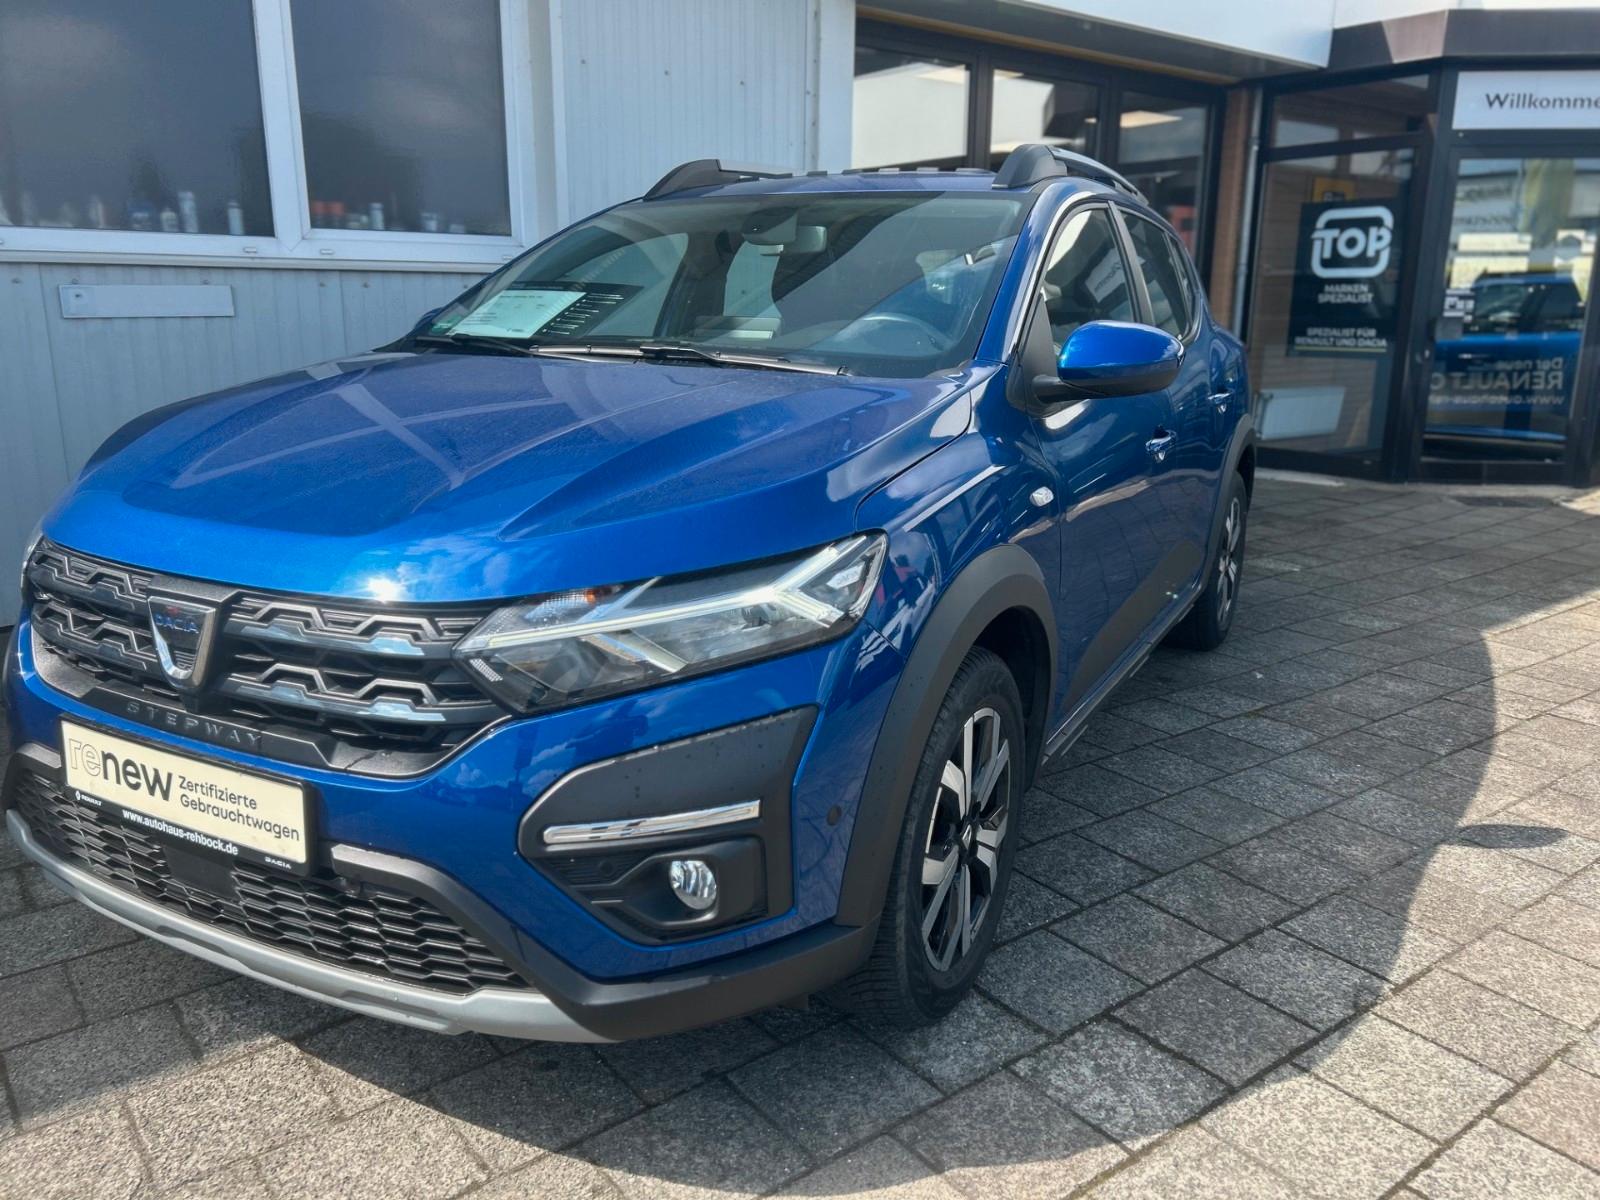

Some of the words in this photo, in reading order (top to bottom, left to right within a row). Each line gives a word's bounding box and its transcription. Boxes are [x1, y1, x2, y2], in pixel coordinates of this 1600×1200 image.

[1311, 226, 1392, 259] TOP
[1318, 293, 1373, 304] SPEZIALIST
[1324, 284, 1368, 293] MARKEN
[127, 702, 262, 745] STEPWAY
[68, 738, 173, 801] renew
[178, 775, 258, 810] Zertifizierte
[122, 809, 239, 856] www.autohaus-rehbock.de
[180, 794, 300, 841] Gebrauchtwagen
